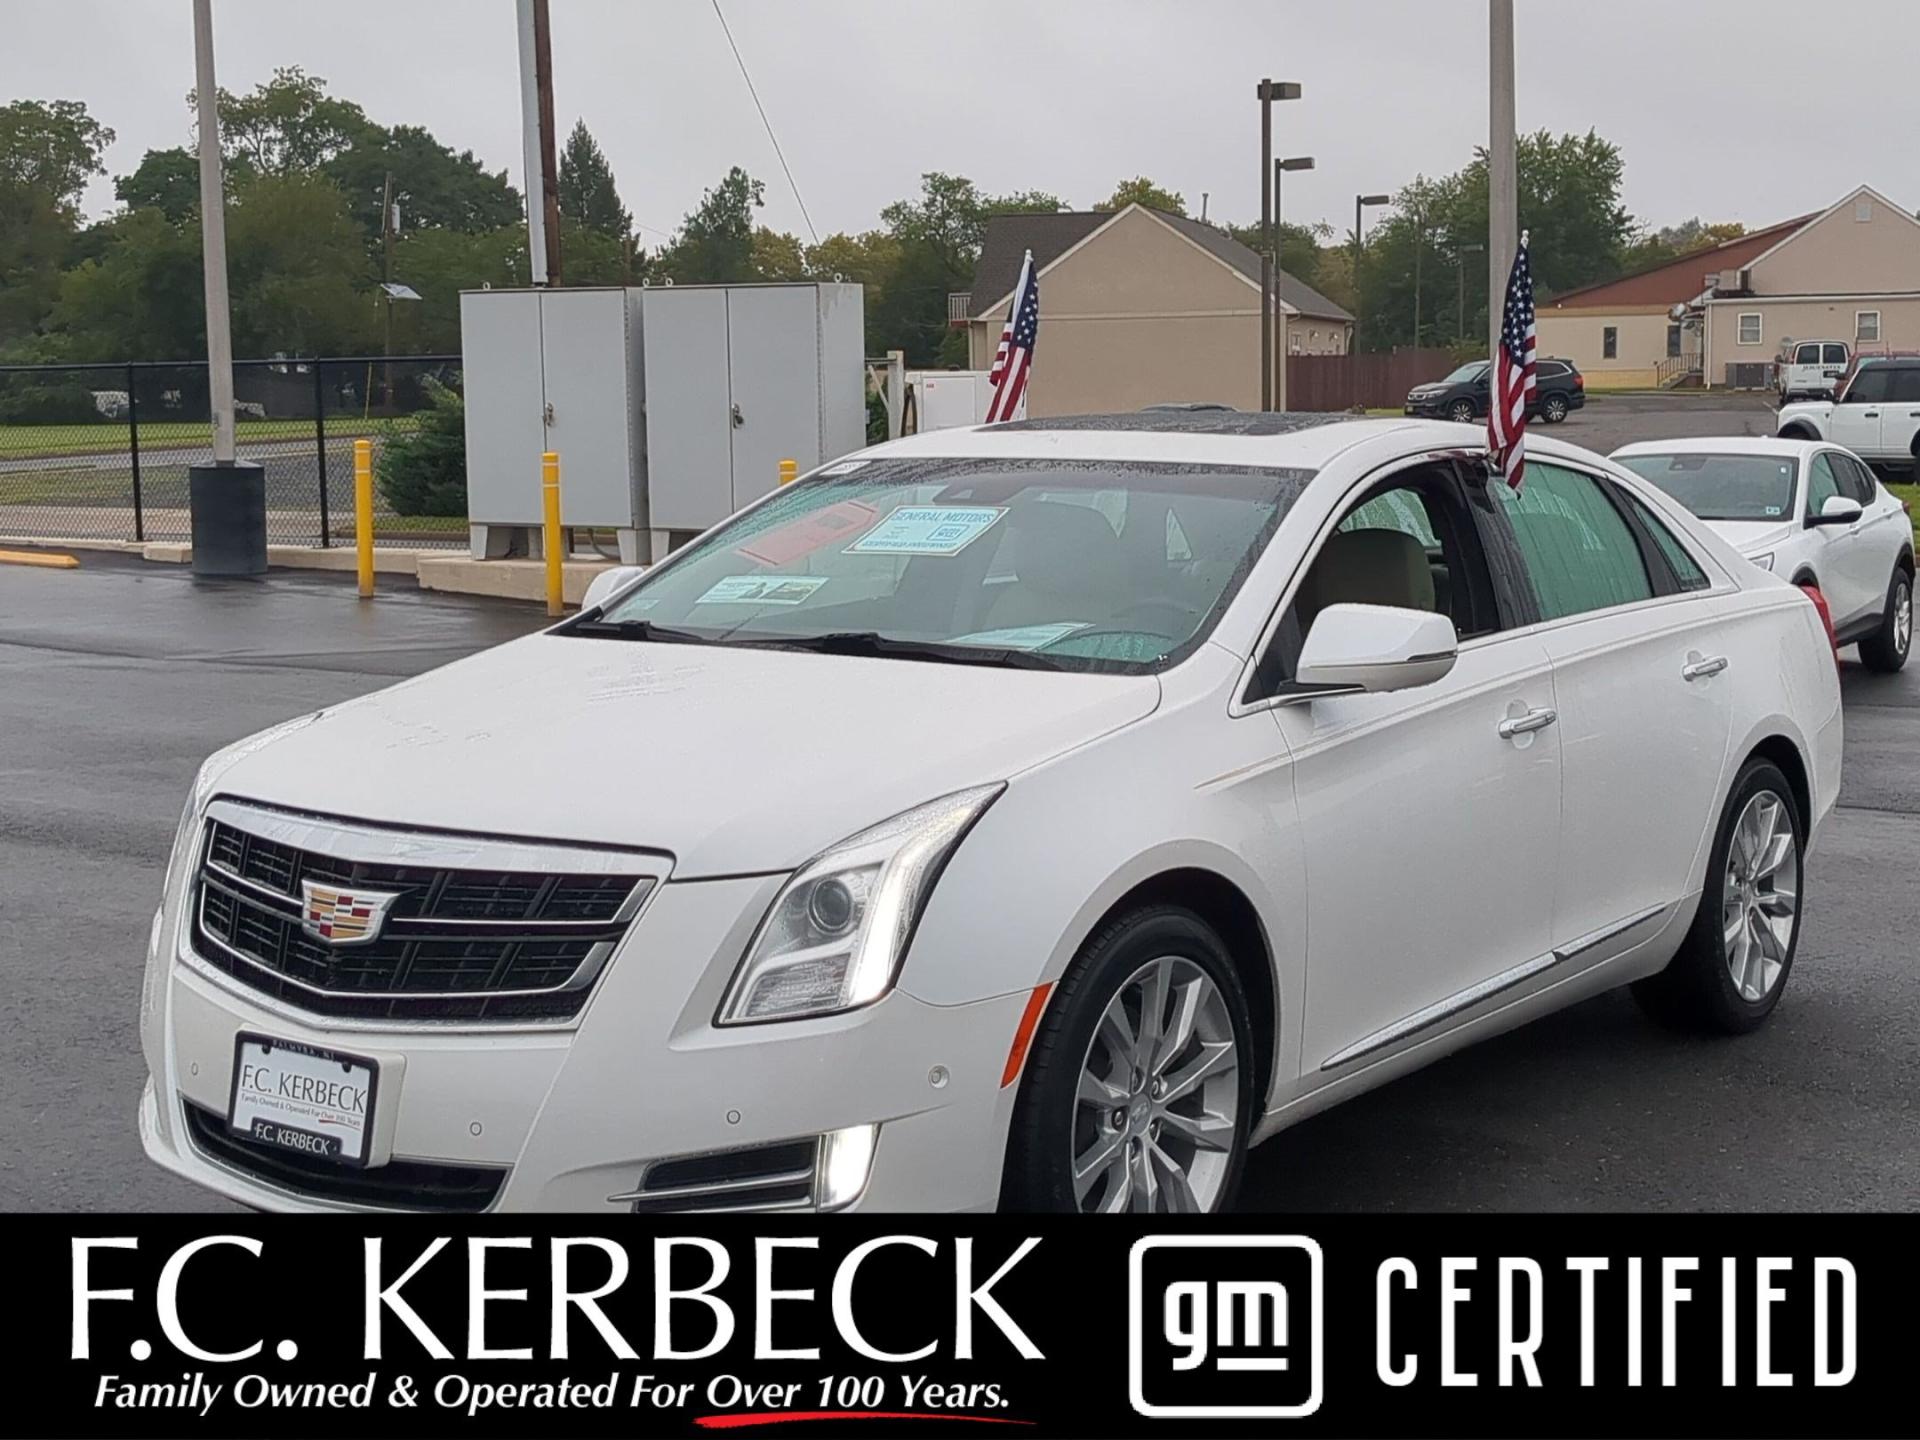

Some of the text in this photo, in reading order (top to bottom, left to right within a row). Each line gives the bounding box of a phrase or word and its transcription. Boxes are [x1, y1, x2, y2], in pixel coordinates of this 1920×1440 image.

[943, 512, 994, 523] MOTORS
[241, 1064, 367, 1114] F.C. KERBECK
[254, 1123, 331, 1156] F.C. KERBECK
